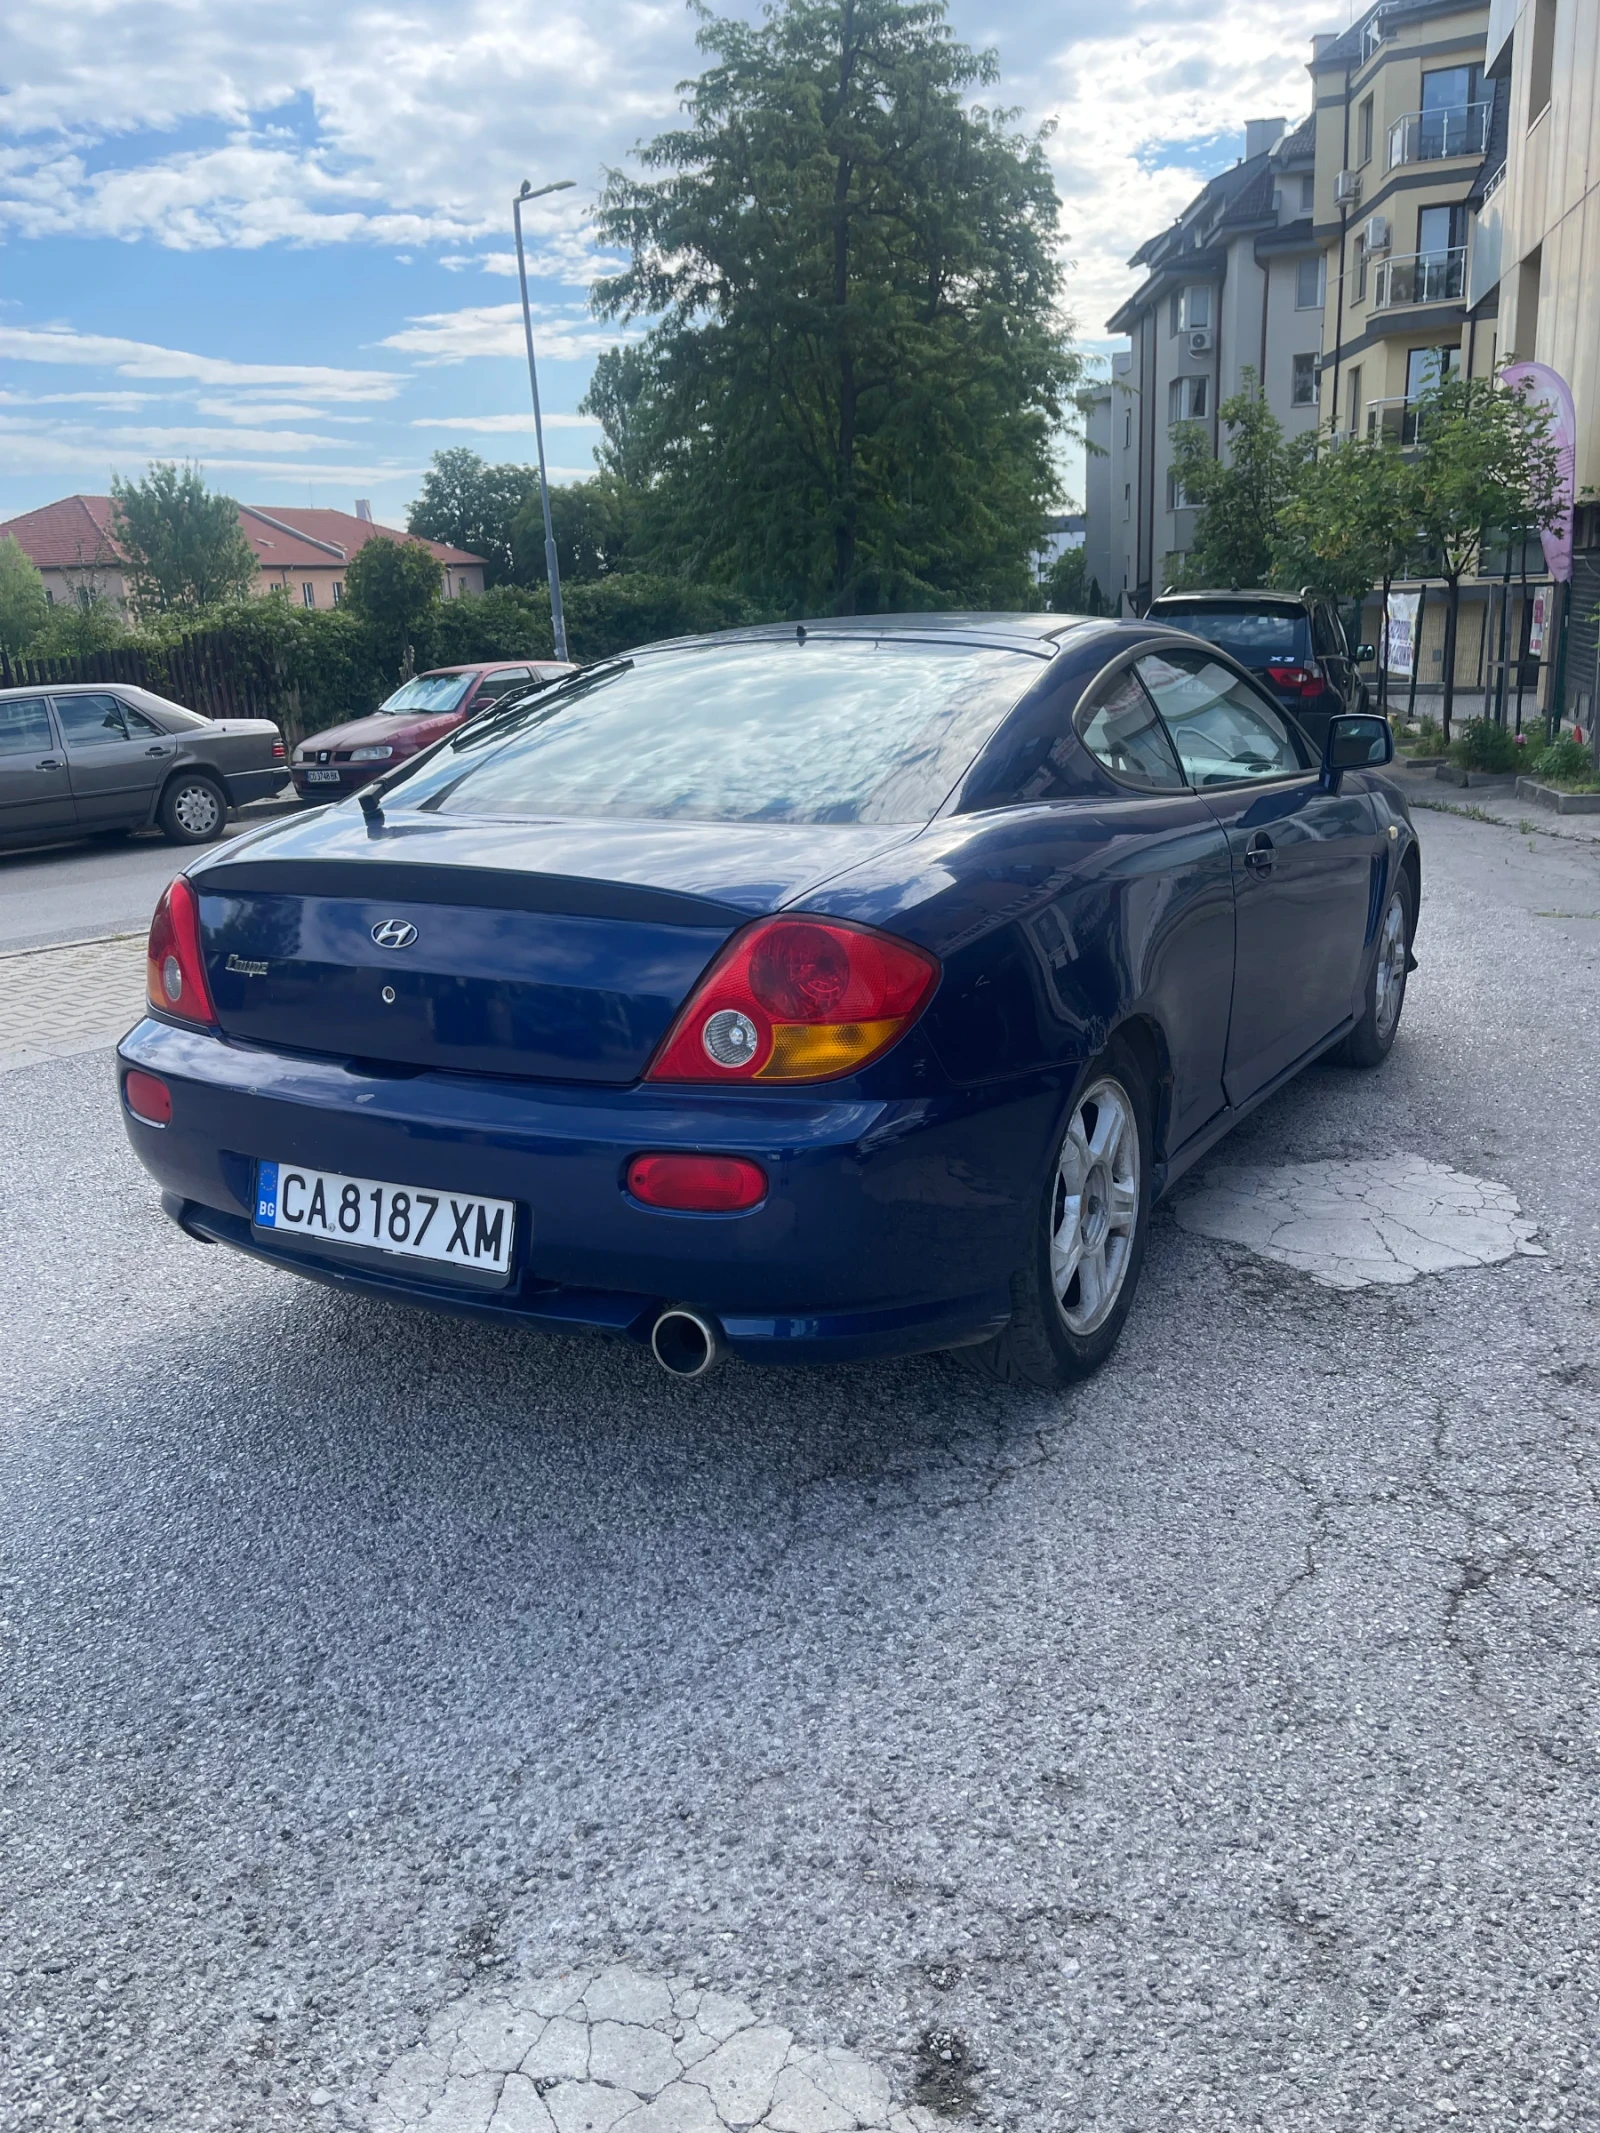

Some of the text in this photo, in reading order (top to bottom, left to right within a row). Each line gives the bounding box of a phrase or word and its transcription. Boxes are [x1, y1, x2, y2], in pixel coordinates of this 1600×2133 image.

[259, 1200, 276, 1217] BG
[282, 1173, 504, 1262] CA 8187 XM
